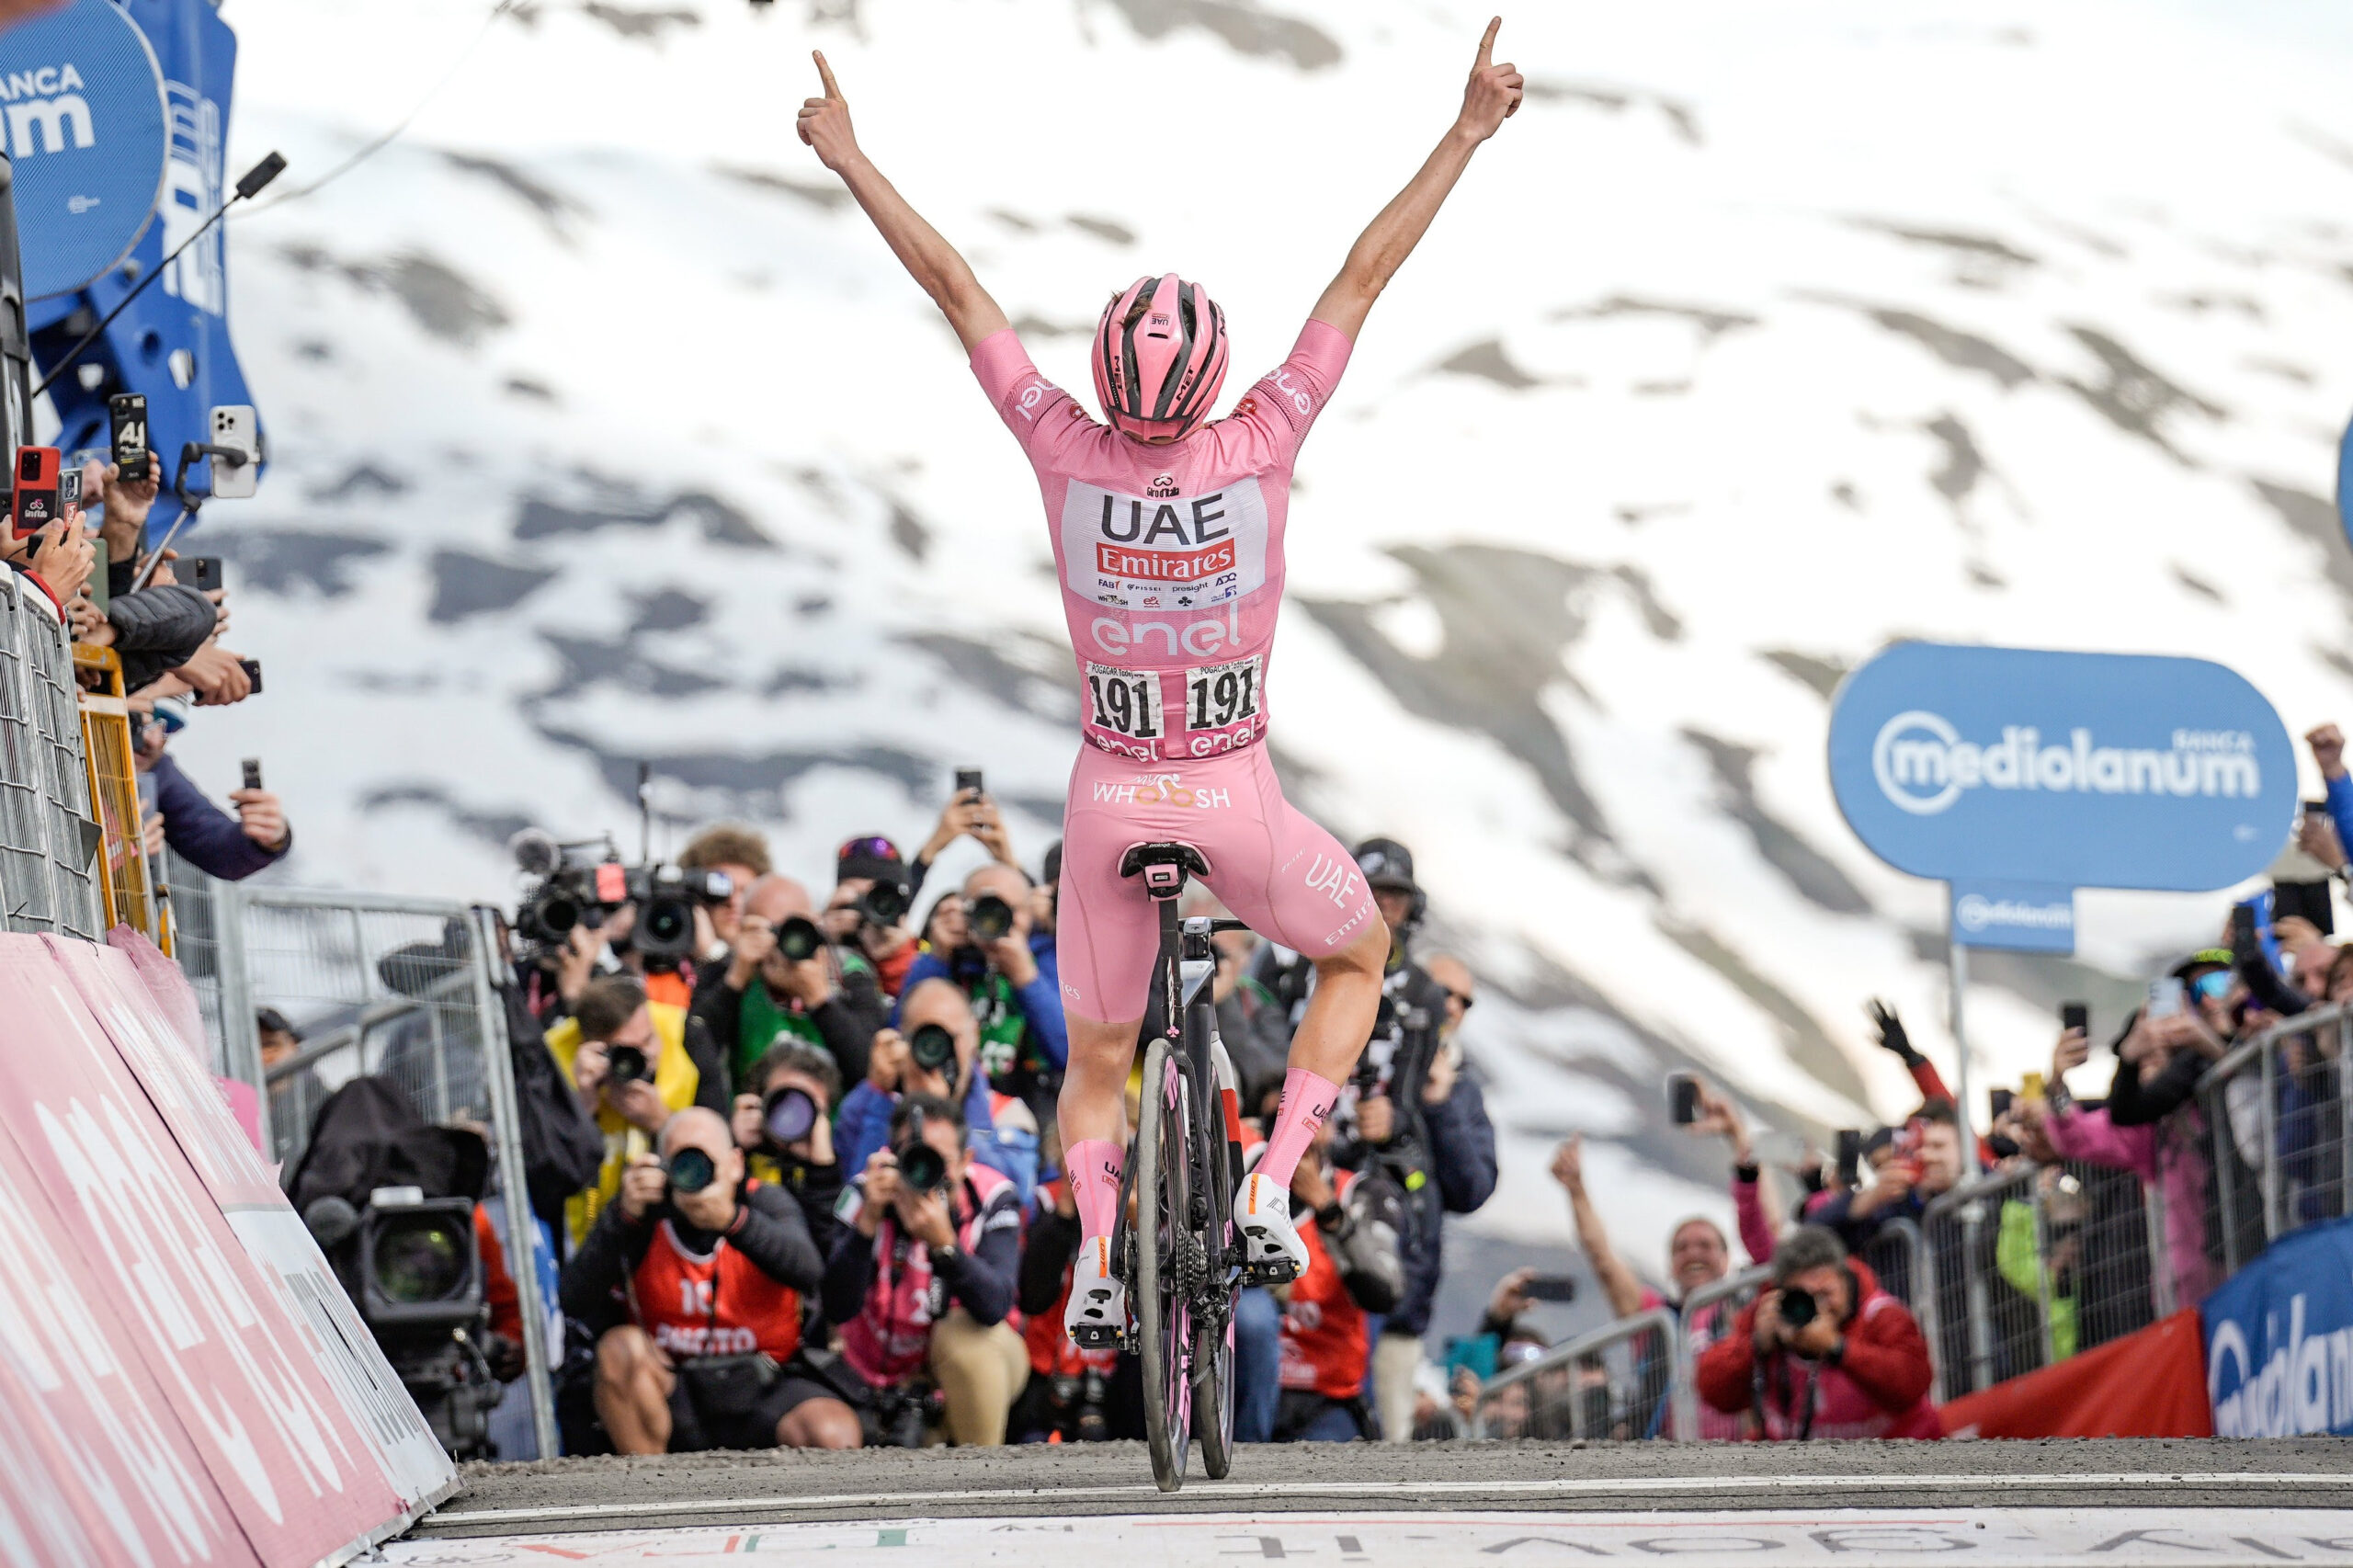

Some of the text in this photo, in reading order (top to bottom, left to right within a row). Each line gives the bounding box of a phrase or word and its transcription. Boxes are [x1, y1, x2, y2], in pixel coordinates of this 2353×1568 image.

[1114, 356, 1123, 390] MET
[1176, 365, 1195, 402] MET
[1147, 486, 1159, 497] Giro
[1101, 494, 1230, 545] UAE
[1102, 548, 1232, 578] Emirates
[1172, 582, 1209, 593] presight
[1091, 601, 1241, 656] enel
[1089, 676, 1156, 737] 191
[1190, 665, 1256, 729] 191
[1097, 734, 1158, 763] enel
[1191, 717, 1256, 756] enel
[2173, 728, 2256, 754] BANCA
[1881, 722, 2260, 800] mediolanum
[1304, 852, 1359, 909] UAE
